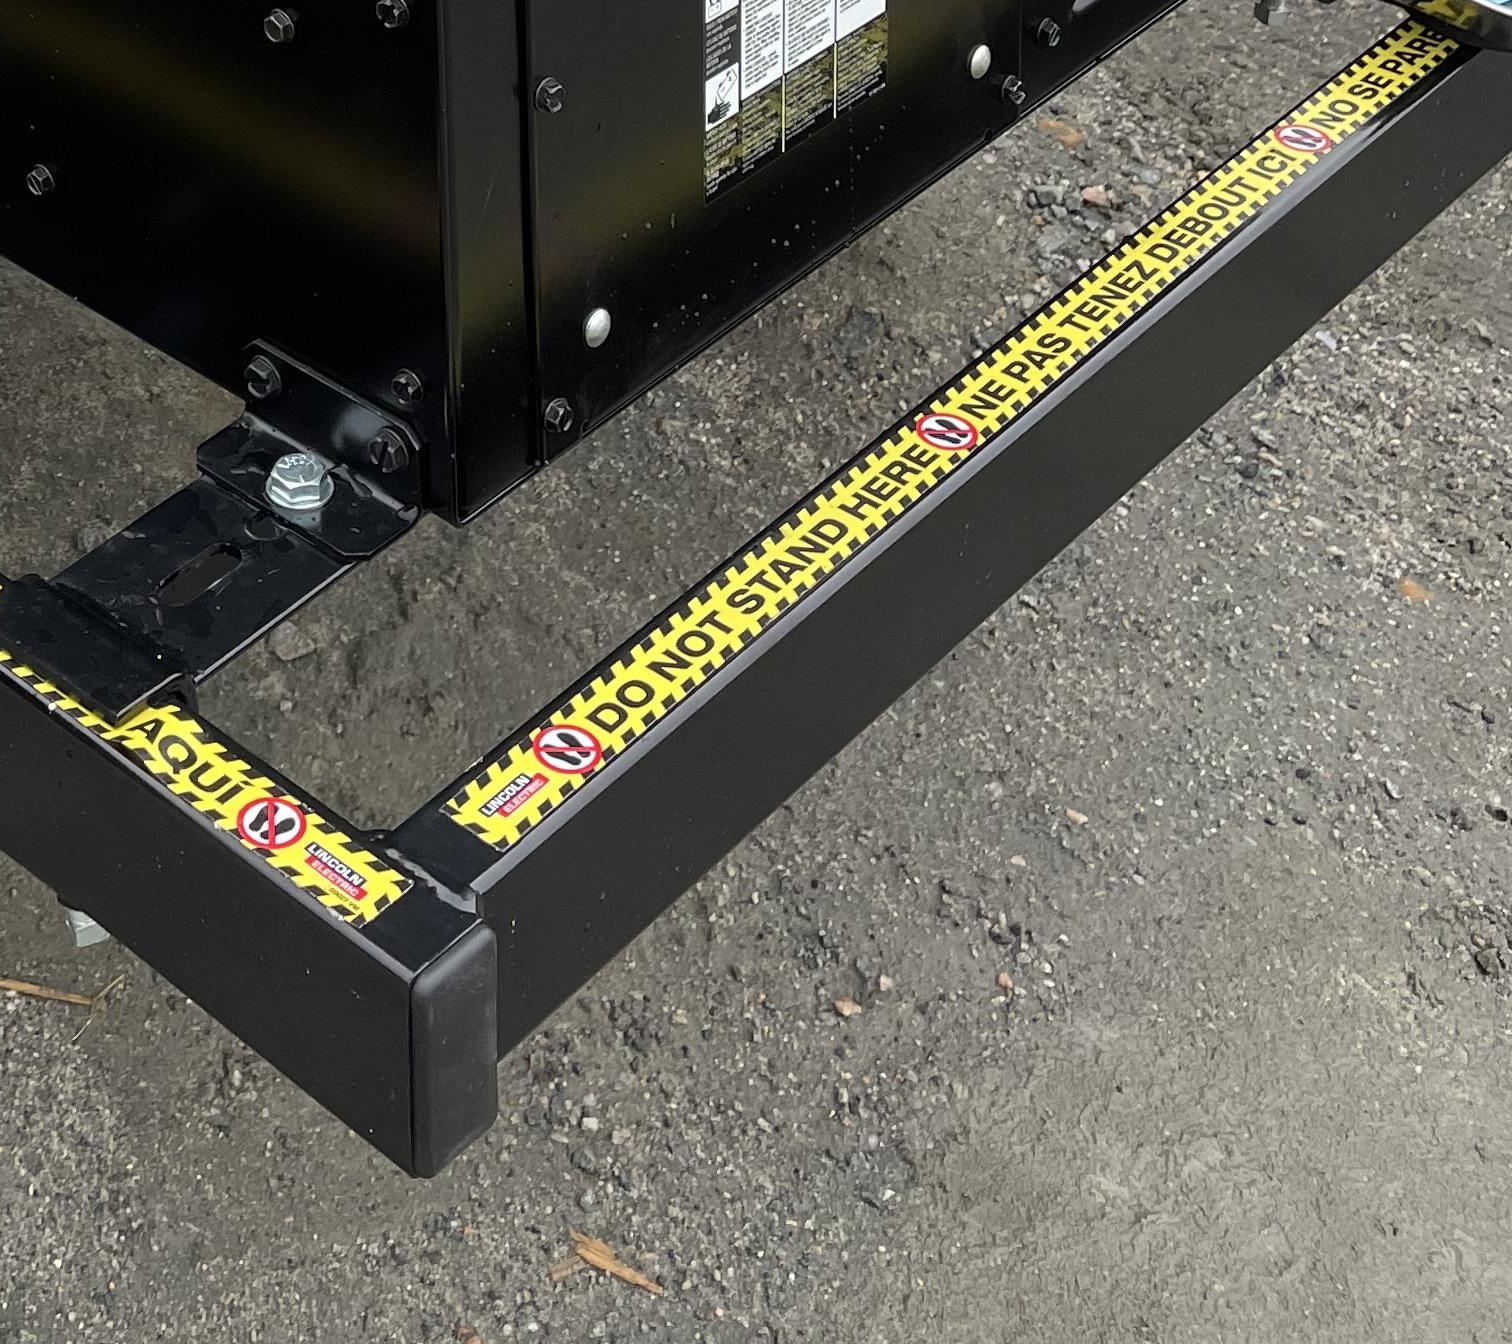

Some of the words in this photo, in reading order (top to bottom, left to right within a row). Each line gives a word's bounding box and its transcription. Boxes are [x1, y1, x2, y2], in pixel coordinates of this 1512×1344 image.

[1309, 99, 1359, 130] NO
[1347, 72, 1395, 100] SE
[1377, 30, 1447, 75] PARE
[958, 379, 1017, 421] NE
[1001, 332, 1073, 382] PAS
[1058, 259, 1160, 333] TENEZ
[1144, 175, 1259, 263] DEBOUT
[1248, 148, 1298, 180] ICI
[585, 678, 655, 733] DO
[646, 610, 734, 682] NOT
[726, 518, 849, 616] STAND
[838, 443, 941, 521] HERE
[482, 775, 531, 815] LINCOLN
[307, 843, 365, 887] LINCOLN
[311, 861, 360, 897] ELECTRIC
